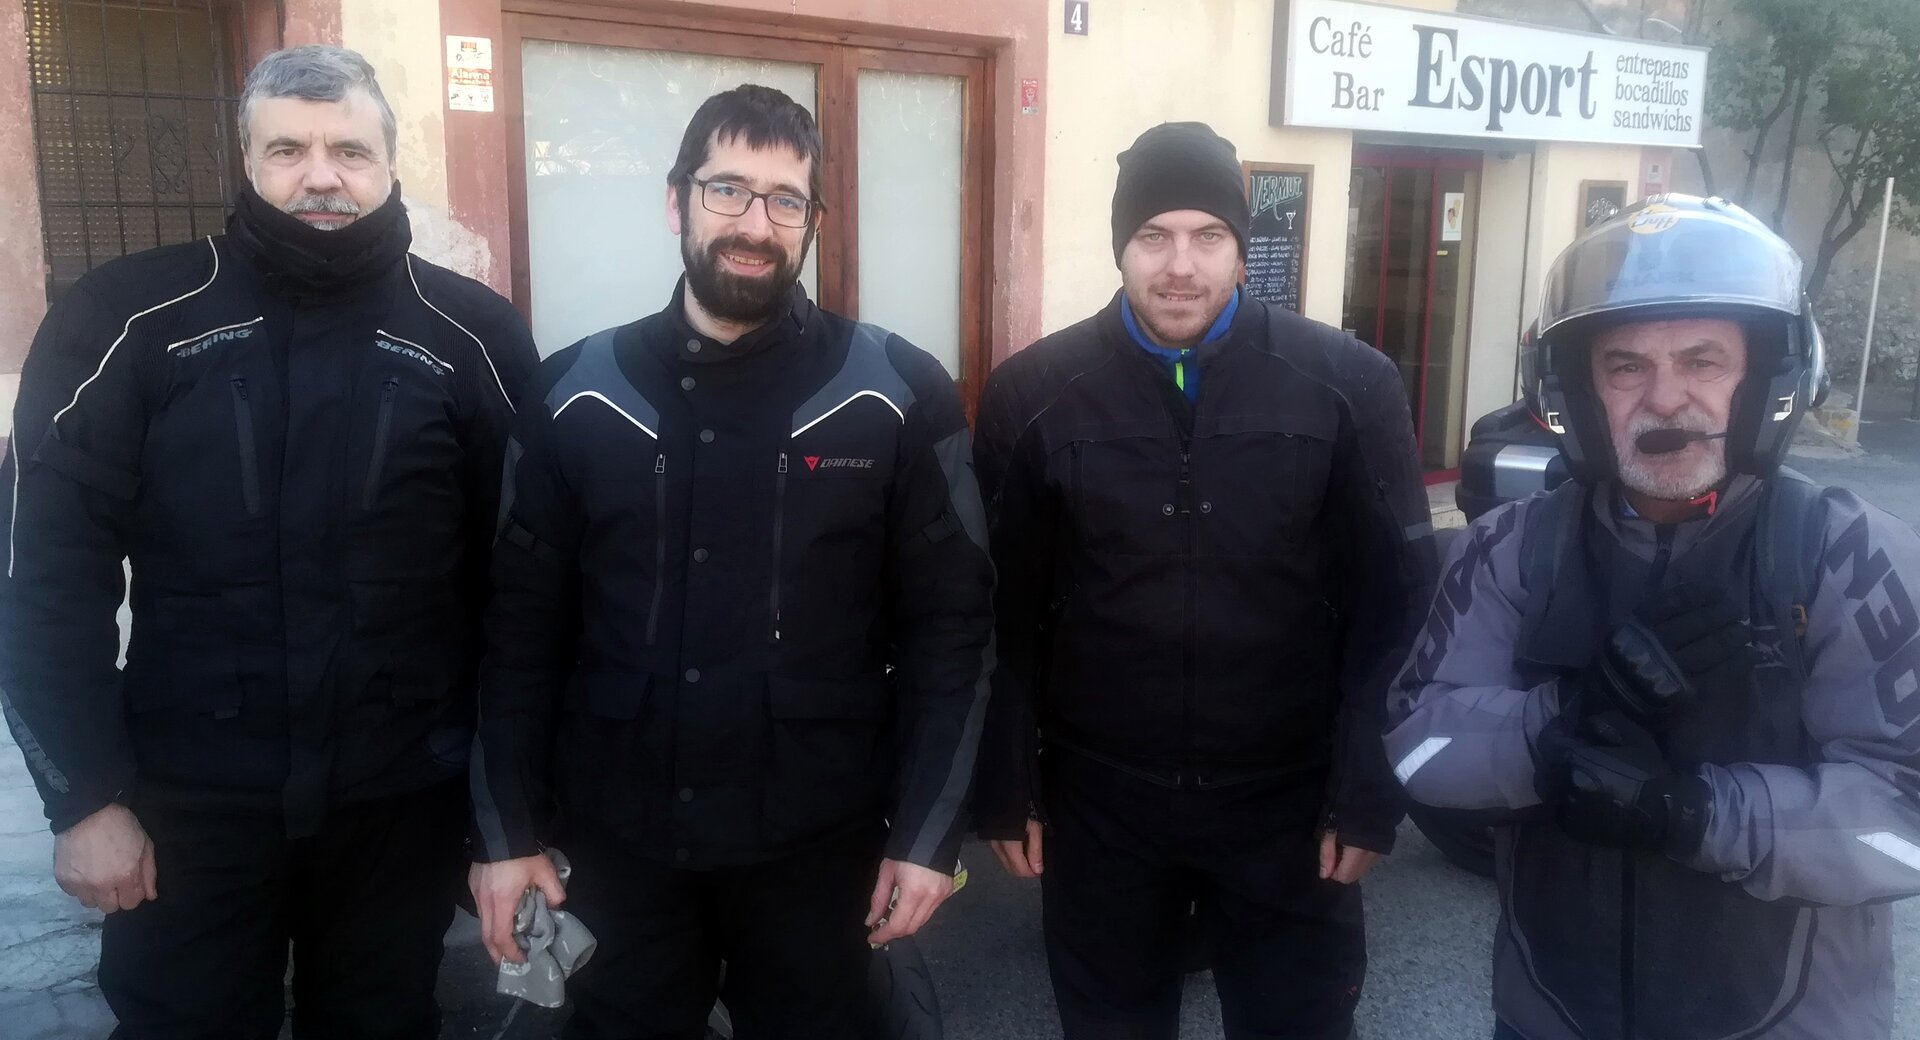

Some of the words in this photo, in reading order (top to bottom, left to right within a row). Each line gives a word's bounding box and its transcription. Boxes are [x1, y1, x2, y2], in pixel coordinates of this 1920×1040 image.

[1071, 3, 1083, 31] 4
[1308, 16, 1373, 58] Café
[1408, 24, 1599, 131] Esport
[1615, 53, 1690, 82] entrepans
[1331, 71, 1385, 111] Bar
[1614, 79, 1690, 107] bocadillos
[1613, 107, 1692, 132] sandwichs
[176, 329, 253, 358] BERING
[375, 339, 446, 376] BERING
[820, 457, 875, 468] DAINESE
